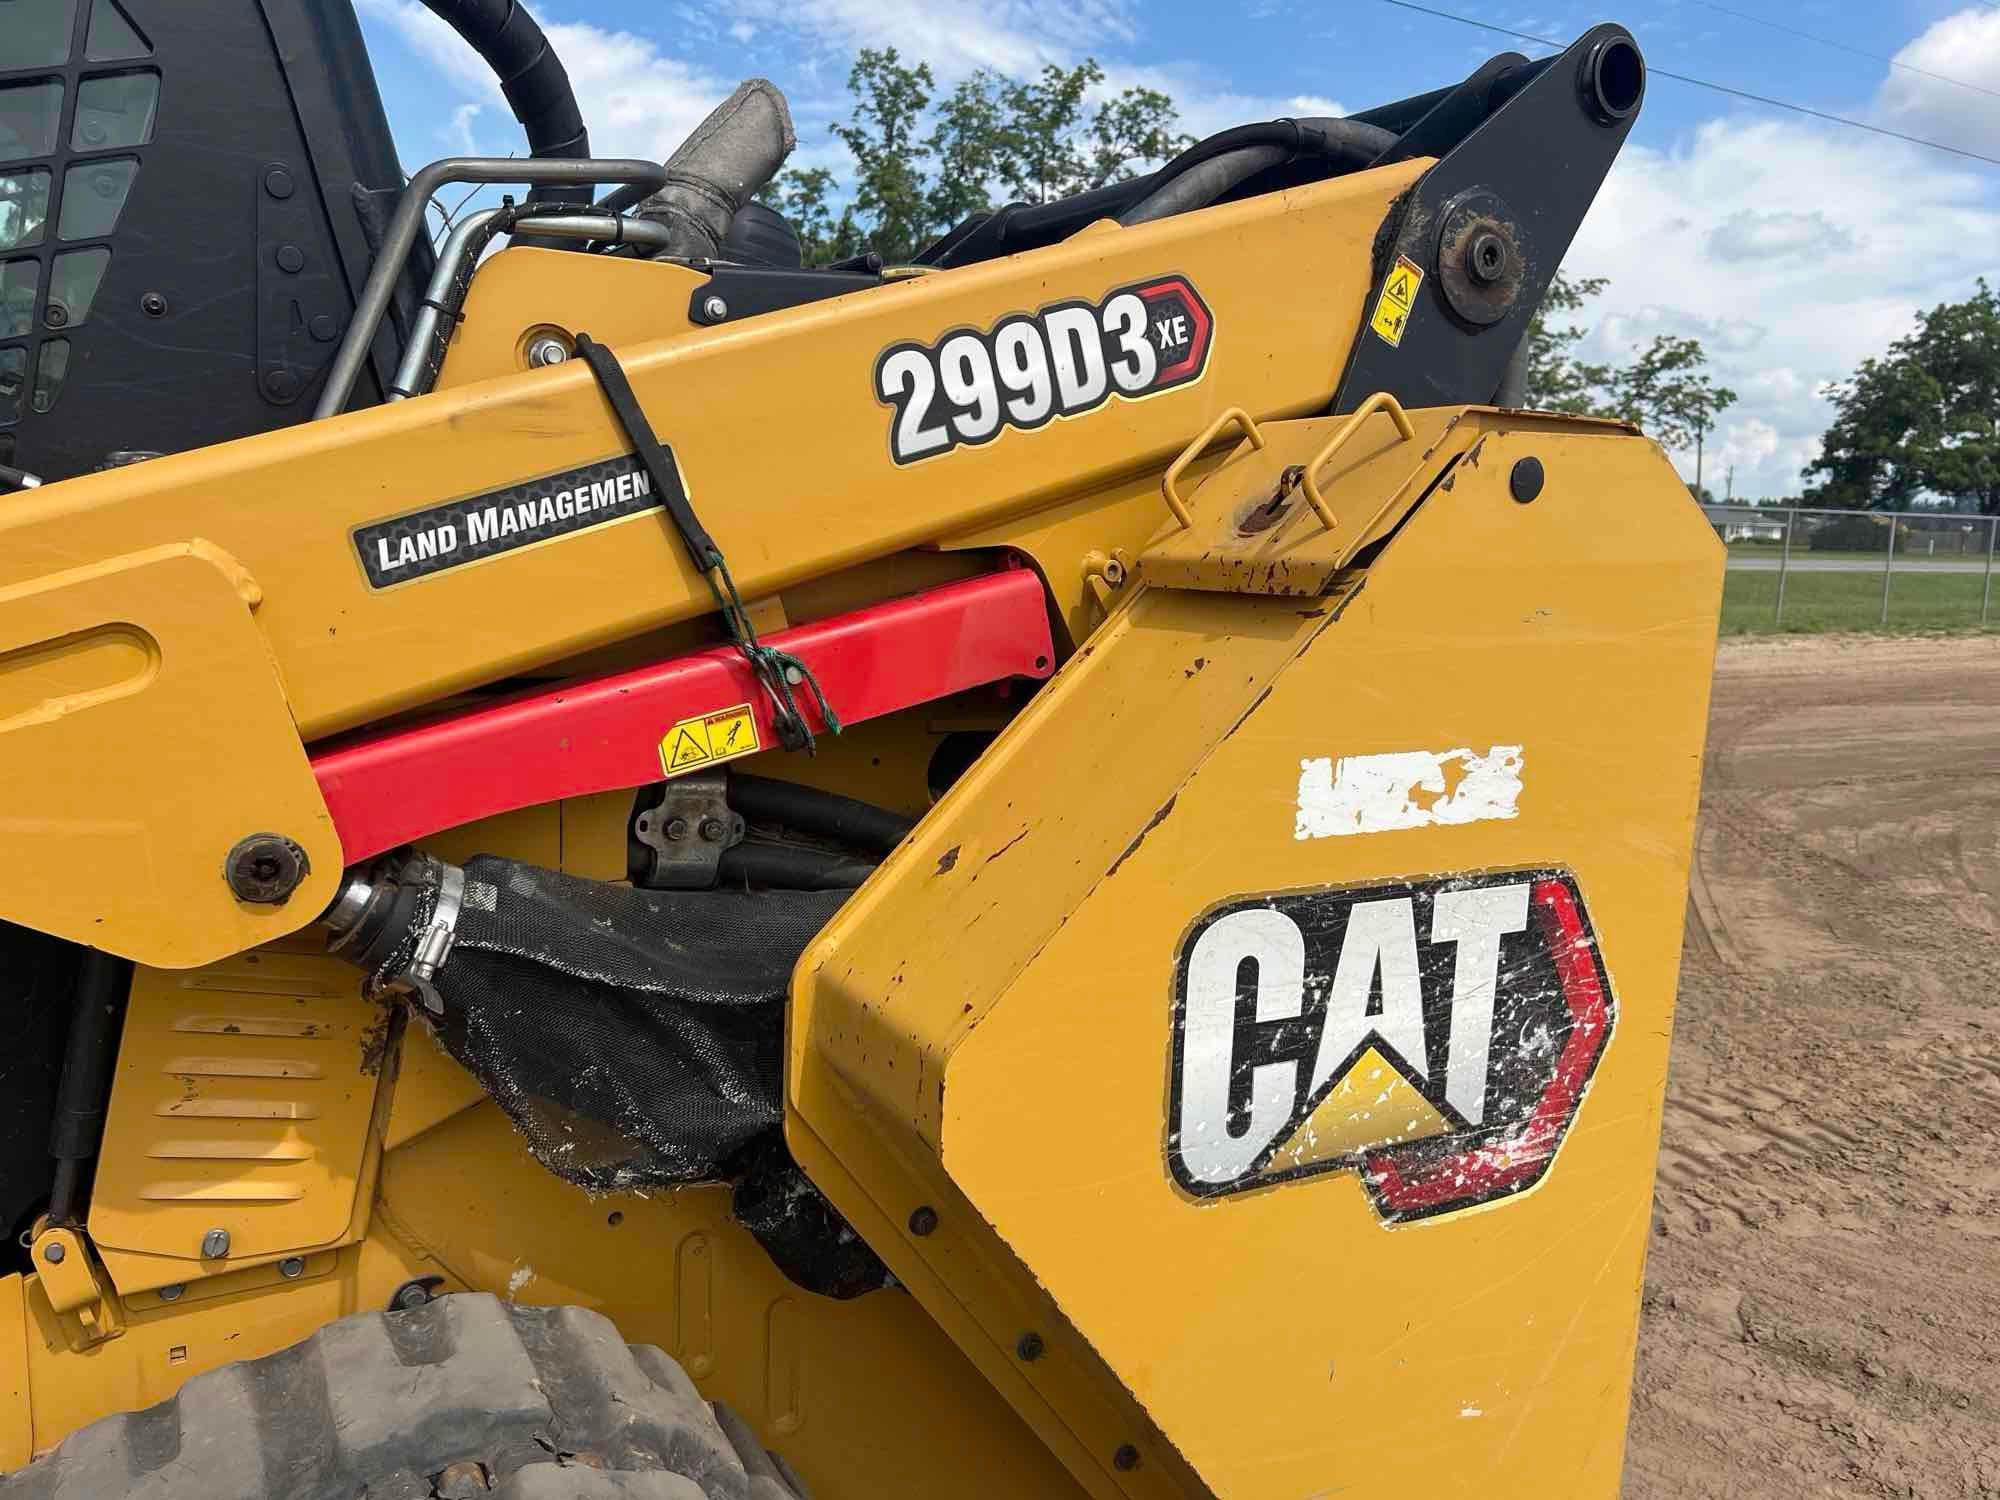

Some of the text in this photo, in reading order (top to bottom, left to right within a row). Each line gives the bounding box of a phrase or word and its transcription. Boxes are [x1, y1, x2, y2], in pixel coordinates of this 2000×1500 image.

[881, 294, 1189, 457] 299D3 XE
[377, 470, 651, 572] LAND MANAGEMEN
[1180, 883, 1531, 1183] CAT
